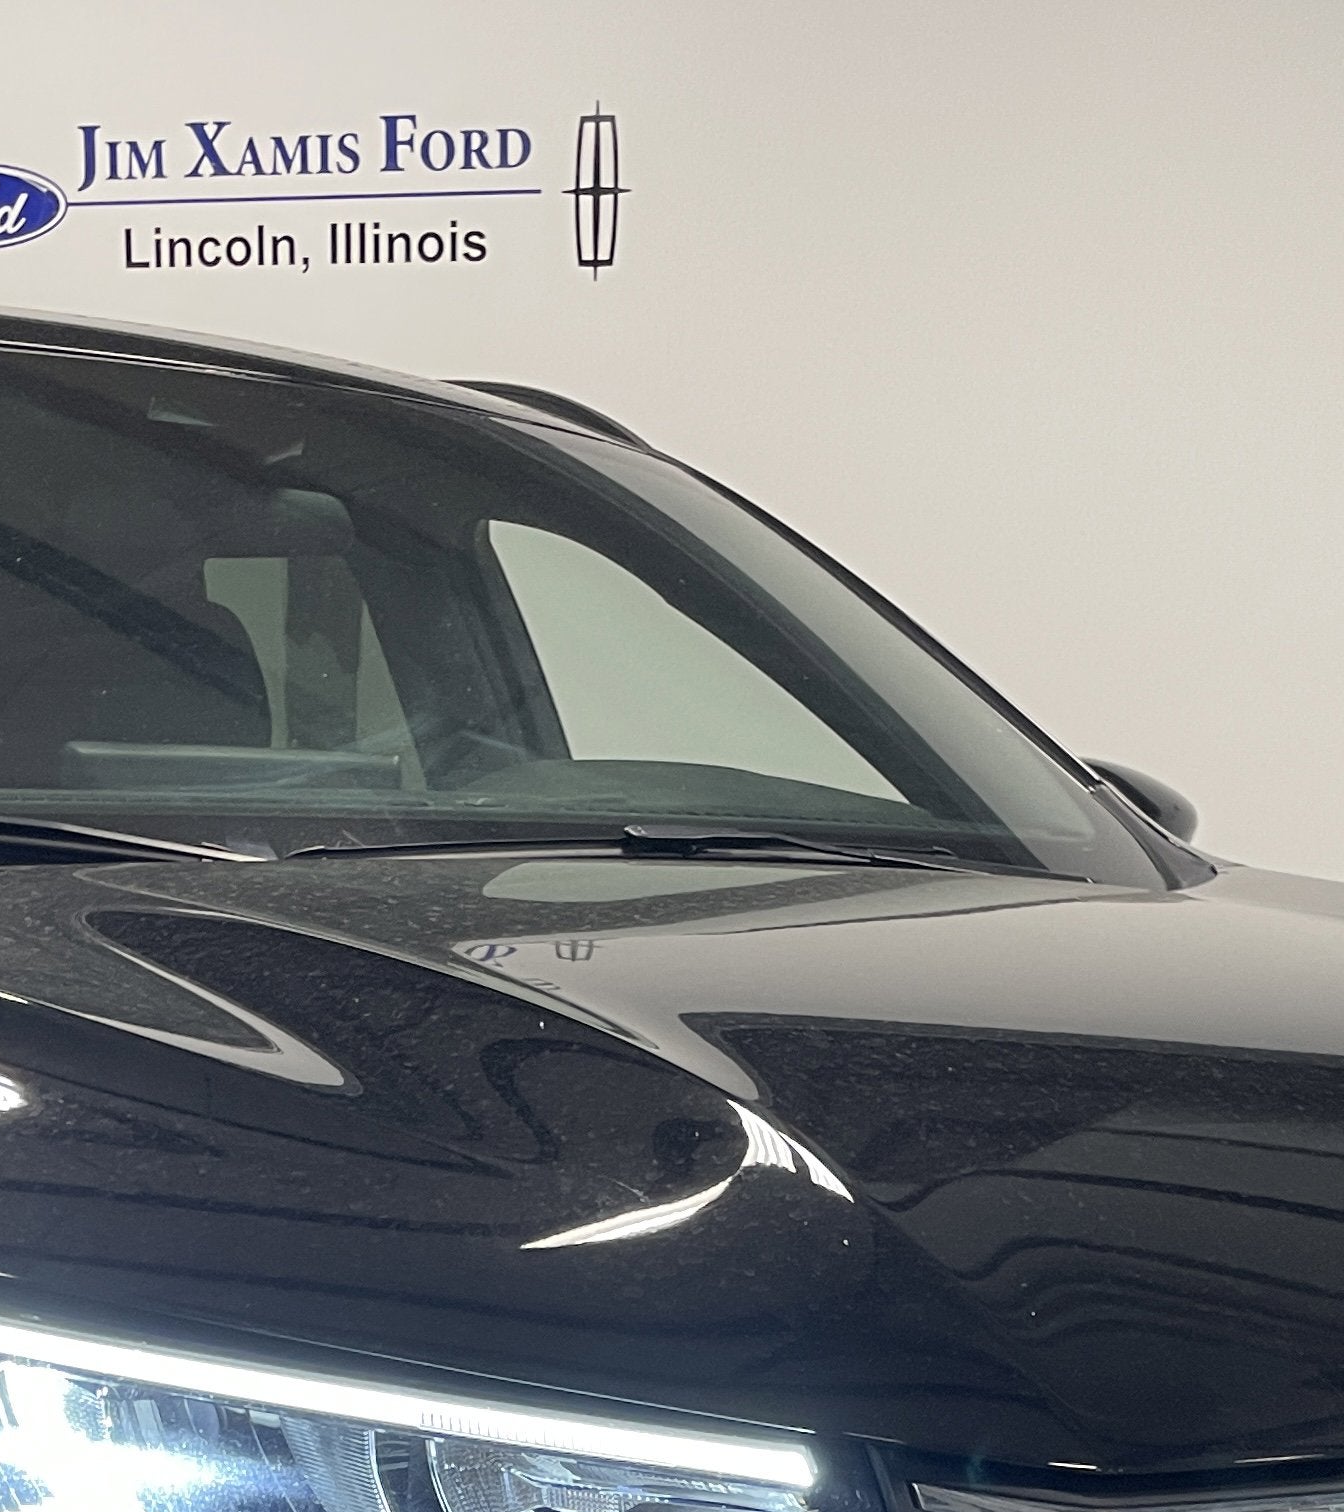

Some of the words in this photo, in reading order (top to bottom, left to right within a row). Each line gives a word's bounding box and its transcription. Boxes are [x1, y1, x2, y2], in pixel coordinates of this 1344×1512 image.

[77, 125, 167, 192] JIM
[184, 121, 360, 178] XAMIS
[379, 114, 532, 173] FORD
[124, 224, 310, 274] Lincoln,
[330, 220, 487, 265] Illinois
